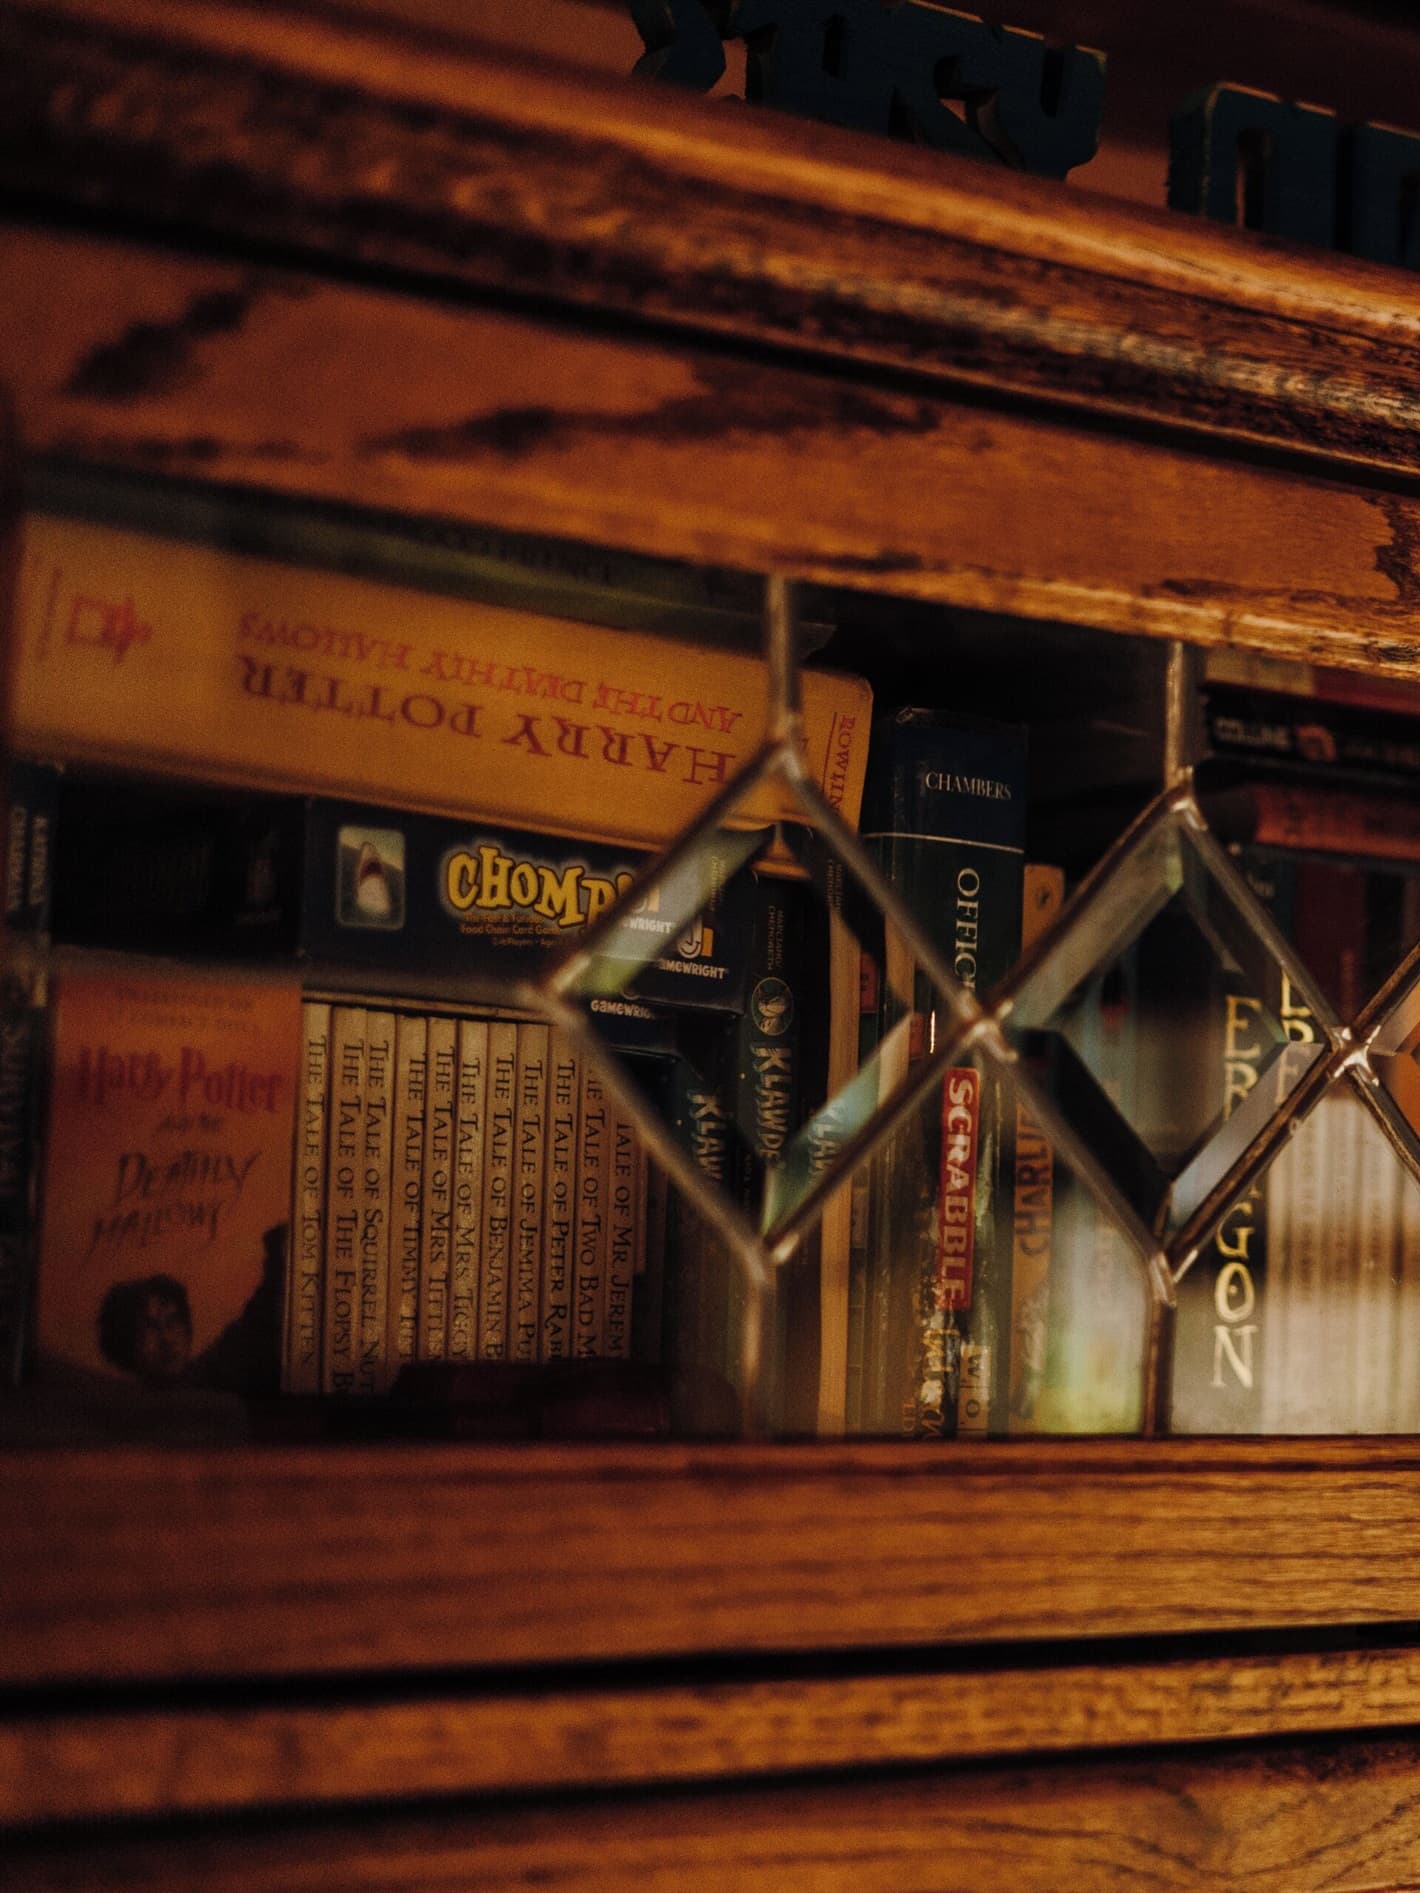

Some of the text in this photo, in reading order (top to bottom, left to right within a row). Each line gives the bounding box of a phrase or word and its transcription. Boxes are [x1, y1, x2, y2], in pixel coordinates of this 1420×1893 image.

[239, 611, 743, 735] AND THE DEATHLY HALLOWS
[237, 654, 737, 786] HARRY POTTER
[829, 714, 856, 816] ROWLIN
[924, 770, 1013, 801] CHAMBERS
[179, 1045, 283, 1114] Potter
[342, 1038, 364, 1086] THE
[368, 1040, 389, 1088] THE
[407, 1053, 428, 1101] THE
[435, 1046, 456, 1093] THE
[461, 1057, 481, 1105] THE
[495, 1052, 515, 1100] THE
[555, 1058, 576, 1105] THE
[338, 1094, 361, 1157] TALE
[365, 1096, 386, 1159] TALE
[404, 1109, 426, 1172] TALE
[432, 1101, 453, 1161] TALE
[458, 1112, 479, 1175] TALE
[491, 1107, 512, 1168] TALE
[553, 1112, 573, 1173] TALE
[583, 1108, 606, 1168] TALE
[299, 1034, 327, 1363] THE TALE OF TOM KITTEN
[336, 1167, 354, 1199] OF
[364, 1168, 380, 1199] OF
[404, 1181, 420, 1214] OF
[432, 1170, 448, 1201] OF
[455, 1184, 472, 1216] OF
[490, 1176, 507, 1209] OF
[516, 1059, 544, 1360] THE TALE OF JEMIMA PU
[552, 1182, 568, 1213] OF
[582, 1177, 599, 1208] OF
[613, 1185, 631, 1217] OF
[941, 1076, 975, 1307] SCRABBLE
[1210, 995, 1262, 1389] ERGON
[335, 1209, 358, 1259] THE
[401, 1219, 421, 1295] TIMMY
[550, 1220, 570, 1293] PETER
[580, 1214, 602, 1267] TWO
[360, 1207, 383, 1328] SQUIRREL
[486, 1215, 508, 1333] BENJAMIN
[578, 1275, 600, 1327] BAD
[607, 1274, 630, 1358] JEREM
